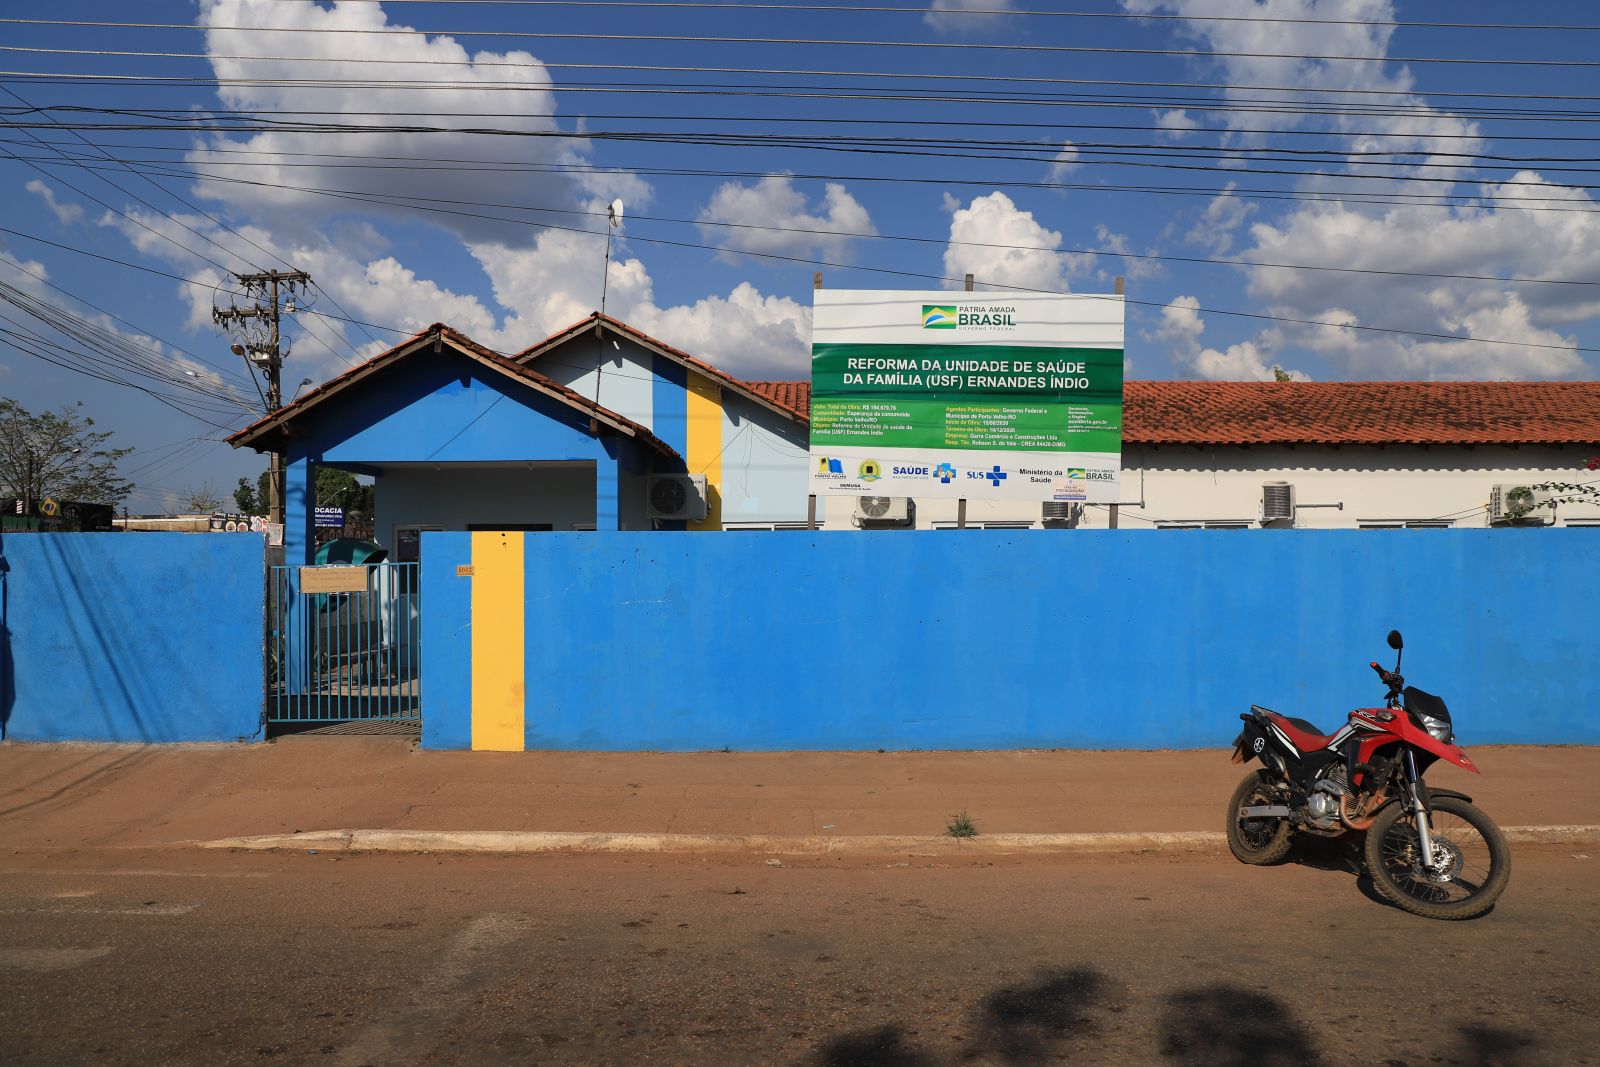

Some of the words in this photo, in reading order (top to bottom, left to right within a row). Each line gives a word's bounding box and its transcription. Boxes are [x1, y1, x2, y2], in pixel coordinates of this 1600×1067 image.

[958, 314, 1016, 326] BRASIL
[848, 358, 918, 370] REFORMA
[921, 360, 942, 371] DA
[945, 360, 1009, 372] UNIDADE
[1013, 361, 1032, 372] DE
[1036, 359, 1086, 373] SAÚDE
[843, 373, 863, 384] DA
[867, 372, 923, 386] FAMÍLIA
[926, 374, 963, 389] (USF)
[968, 376, 1046, 388] ERNANDES
[1050, 374, 1089, 389] ÍNDIO
[893, 465, 929, 475] SAÚDE
[966, 471, 984, 479] SUS
